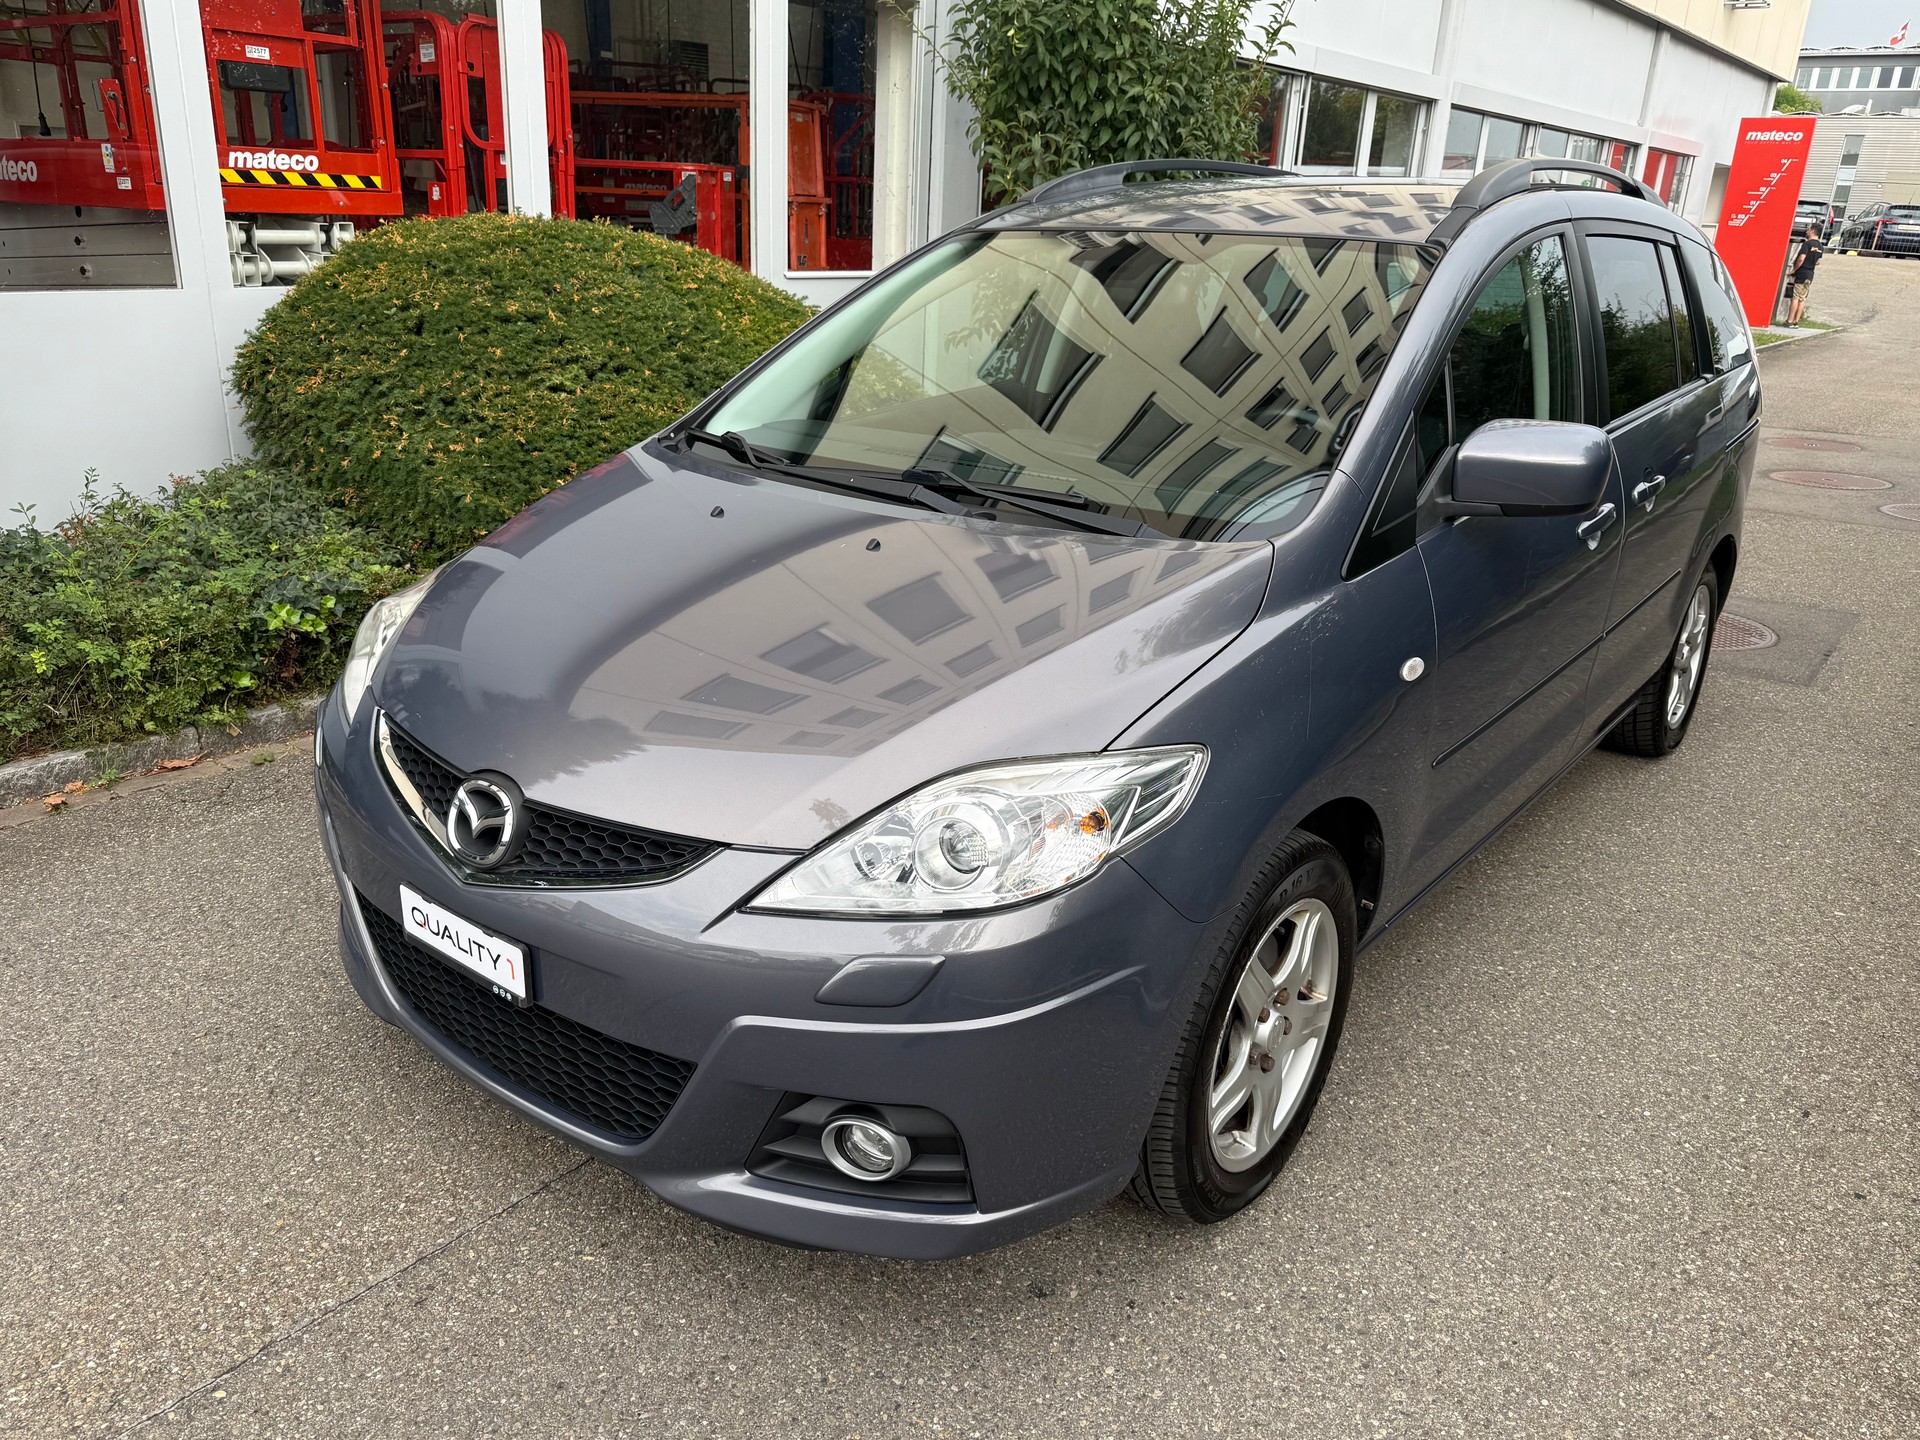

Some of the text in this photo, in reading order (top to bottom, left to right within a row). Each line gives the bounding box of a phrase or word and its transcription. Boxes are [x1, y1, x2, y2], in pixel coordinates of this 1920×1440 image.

[1745, 130, 1804, 141] mateco
[0, 154, 38, 183] teco
[228, 149, 319, 172] mateco
[411, 906, 515, 980] QUALITY 1
